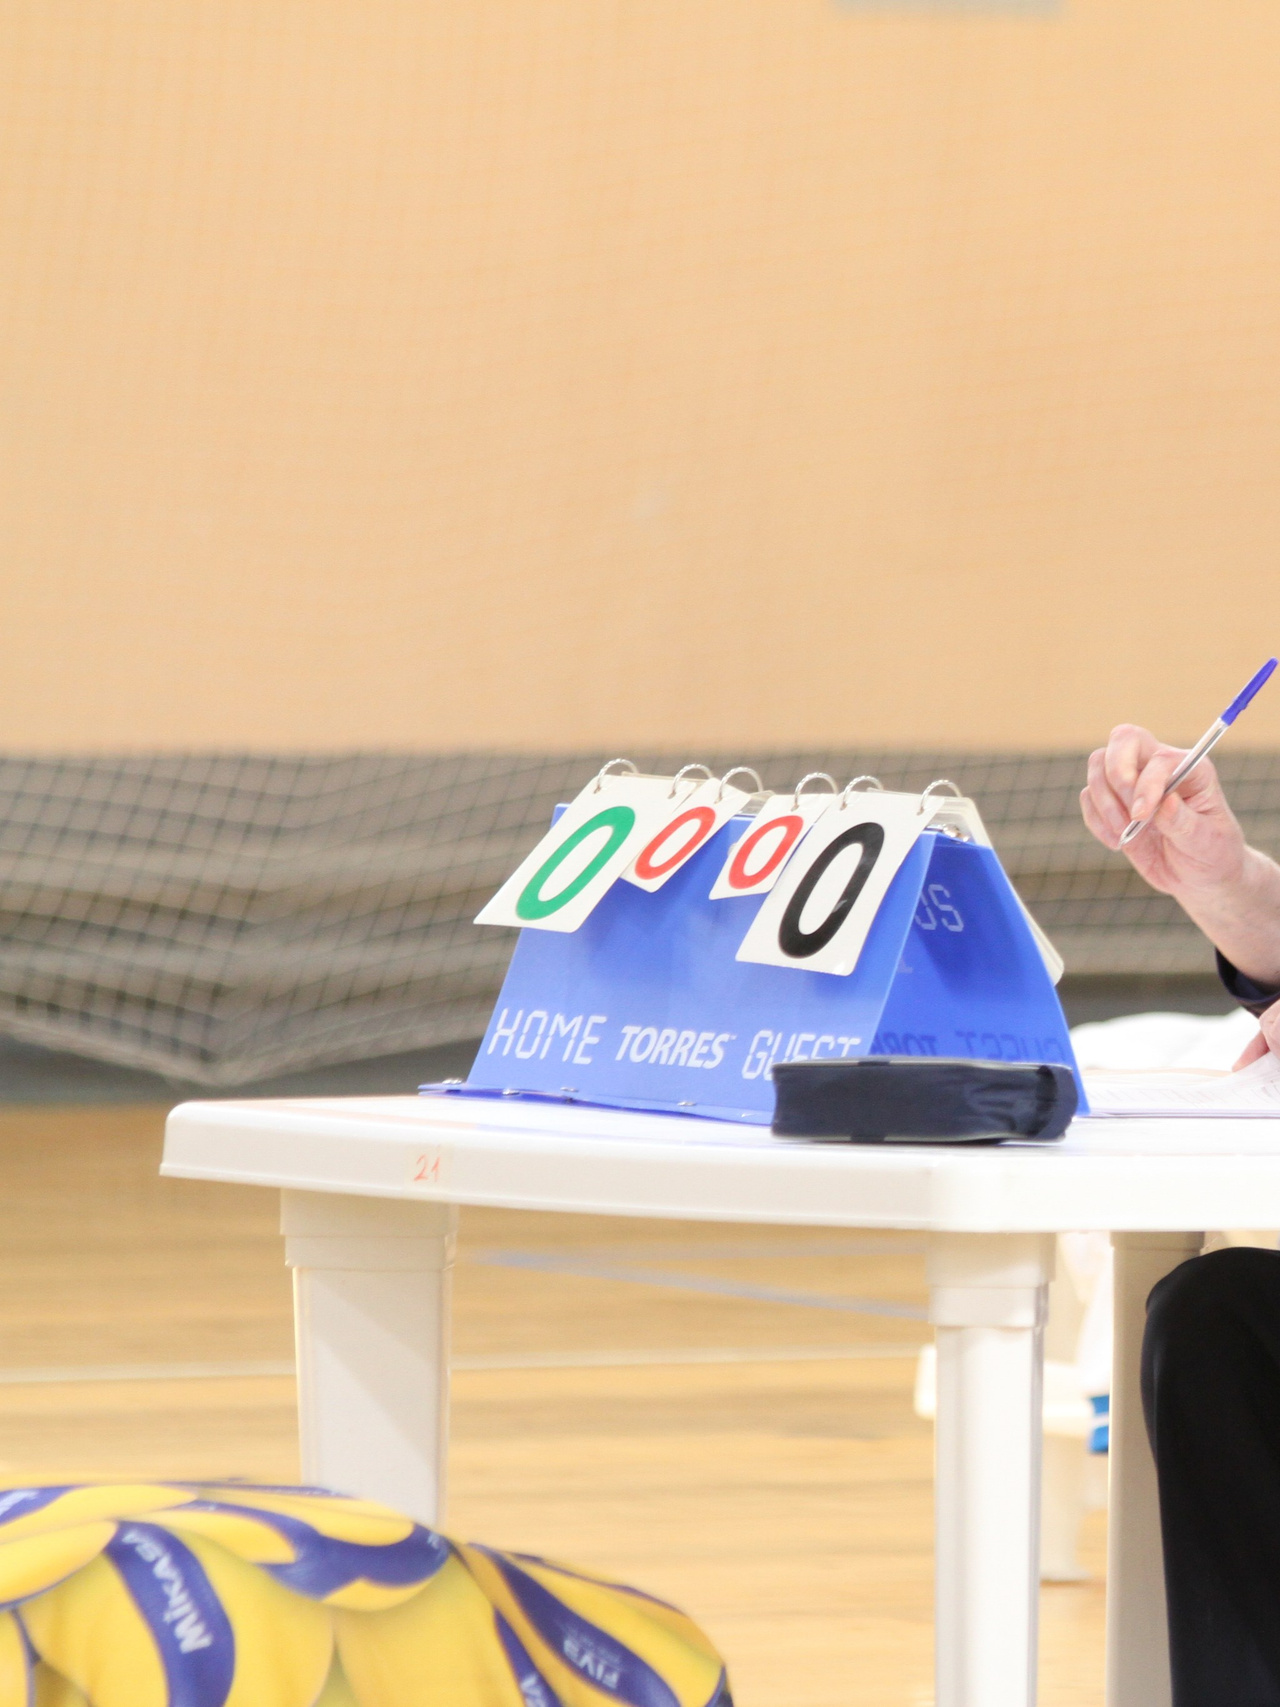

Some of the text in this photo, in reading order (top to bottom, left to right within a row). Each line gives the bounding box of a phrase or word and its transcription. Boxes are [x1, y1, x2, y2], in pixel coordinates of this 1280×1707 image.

[515, 806, 885, 959] 0 0 0 0
[487, 1008, 607, 1065] HOME
[615, 1025, 731, 1070] TORRES
